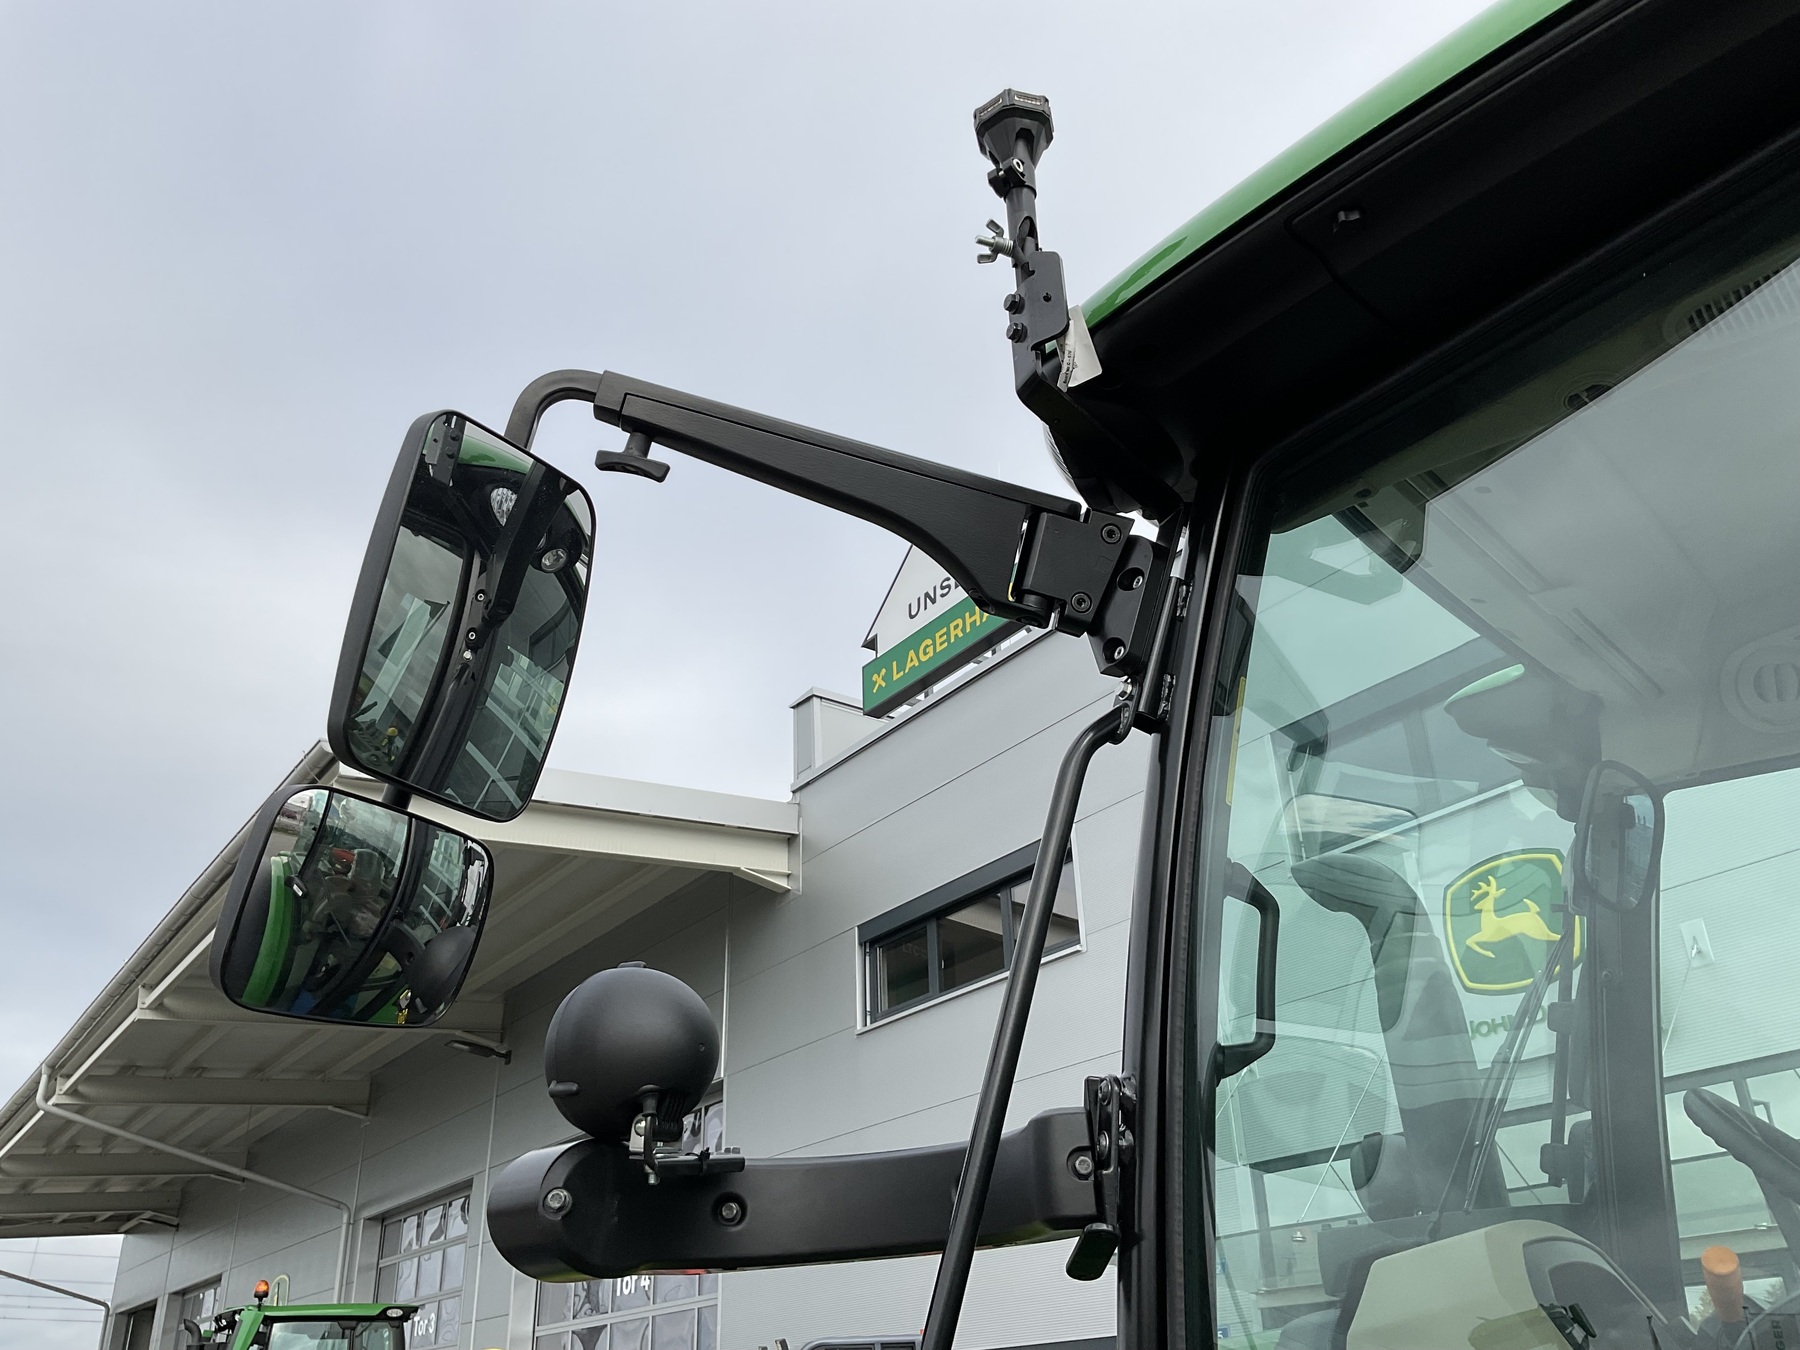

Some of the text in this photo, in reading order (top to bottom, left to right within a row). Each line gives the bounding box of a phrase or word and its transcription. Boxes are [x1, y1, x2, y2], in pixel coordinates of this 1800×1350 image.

[908, 576, 960, 619] UNS
[414, 1313, 436, 1336] Tor 3
